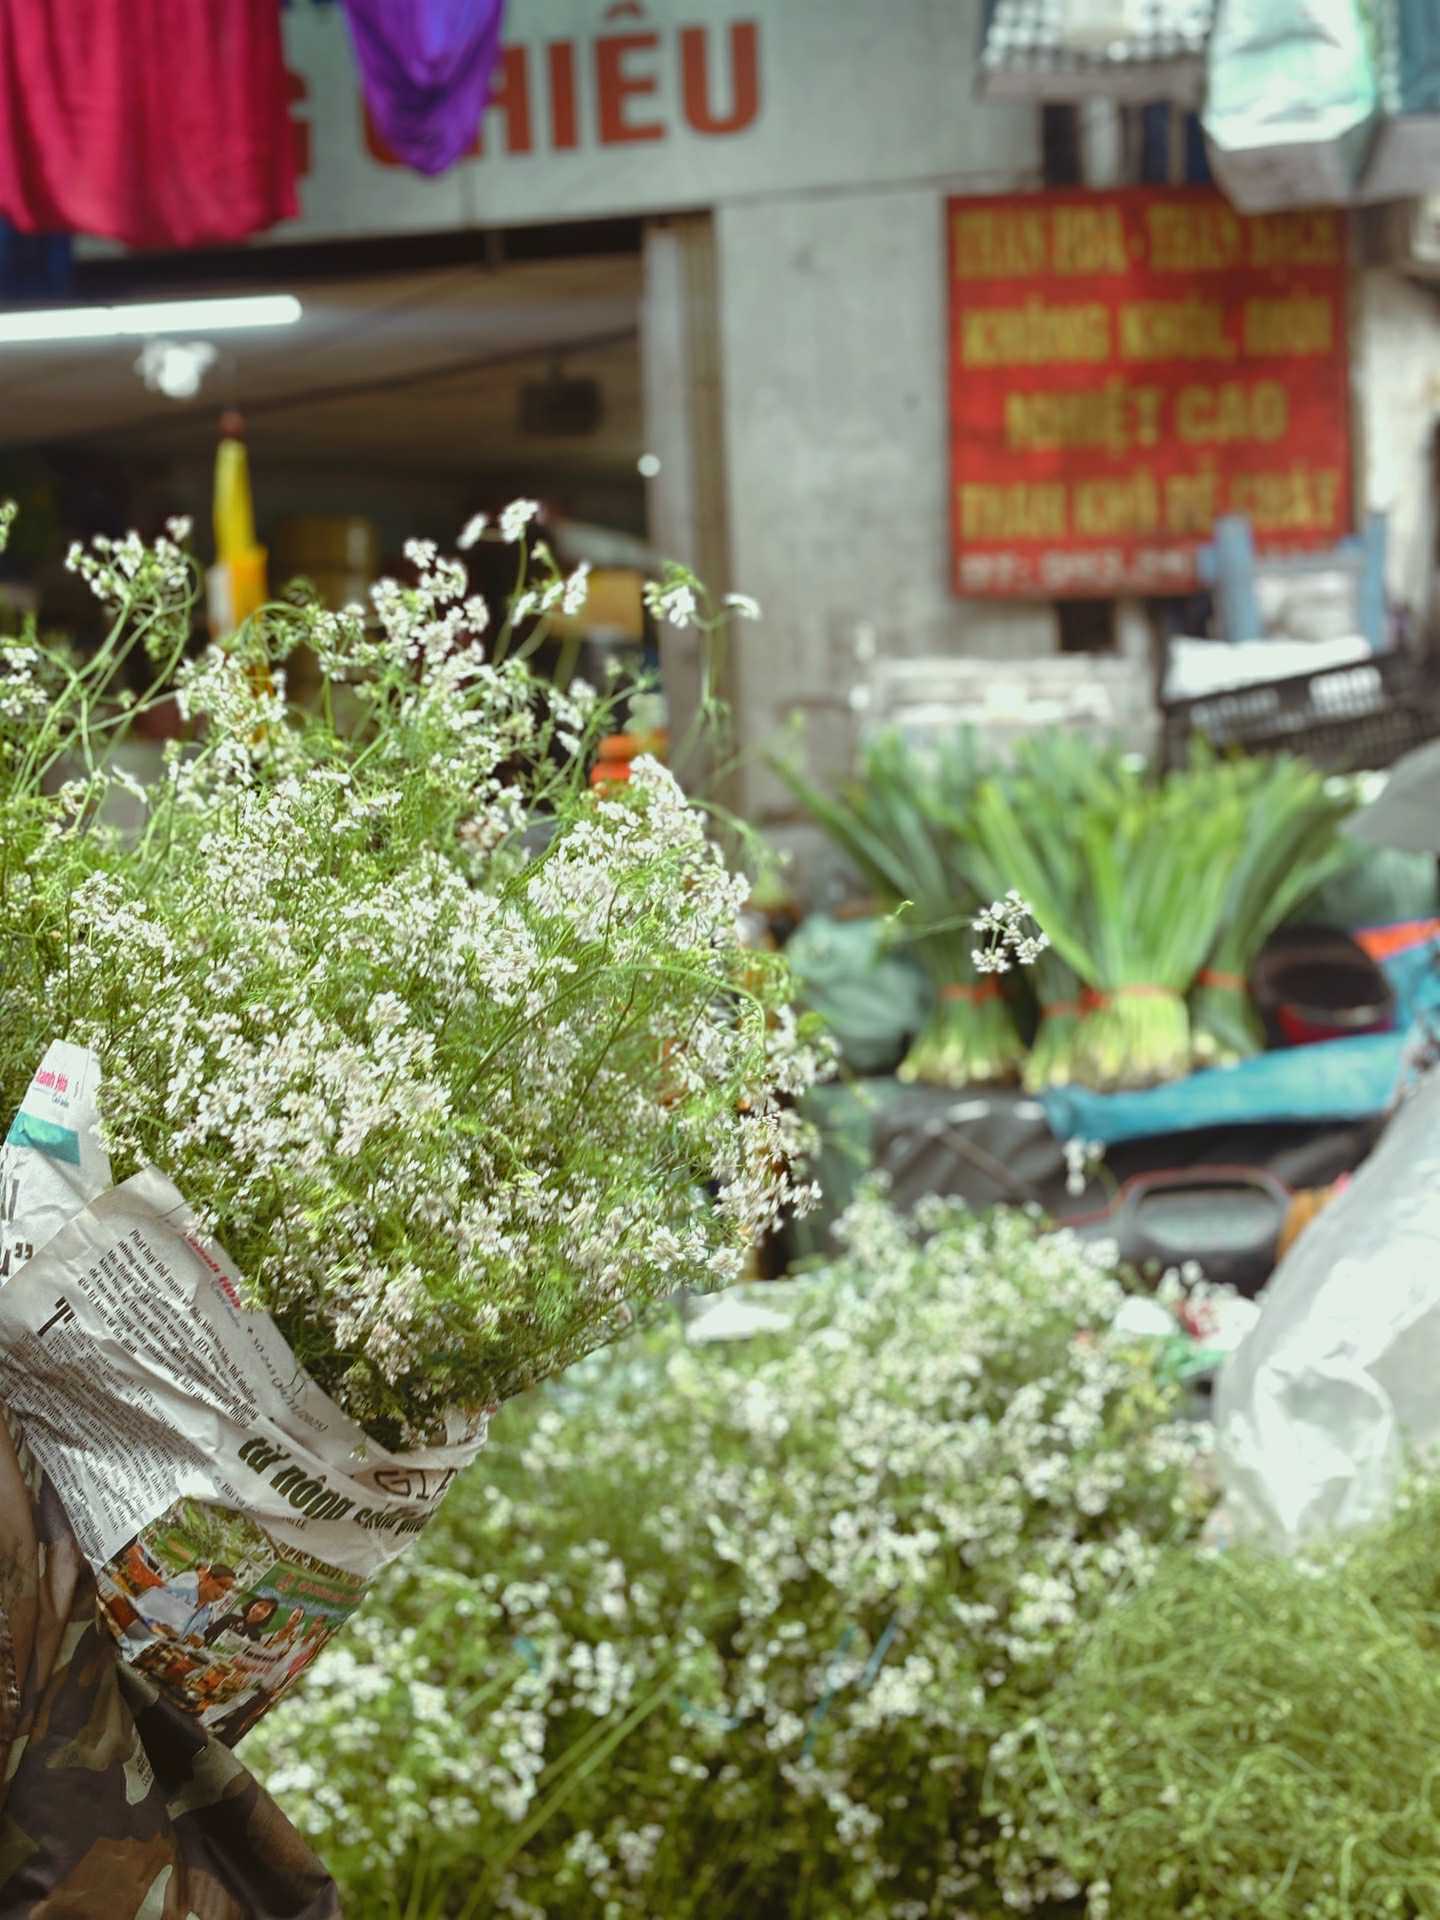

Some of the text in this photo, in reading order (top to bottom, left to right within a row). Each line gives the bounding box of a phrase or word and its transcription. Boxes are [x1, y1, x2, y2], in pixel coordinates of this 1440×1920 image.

[364, 2, 762, 167] HIÊU
[1177, 381, 1288, 443] CAO
[194, 1336, 212, 1355] HTX
